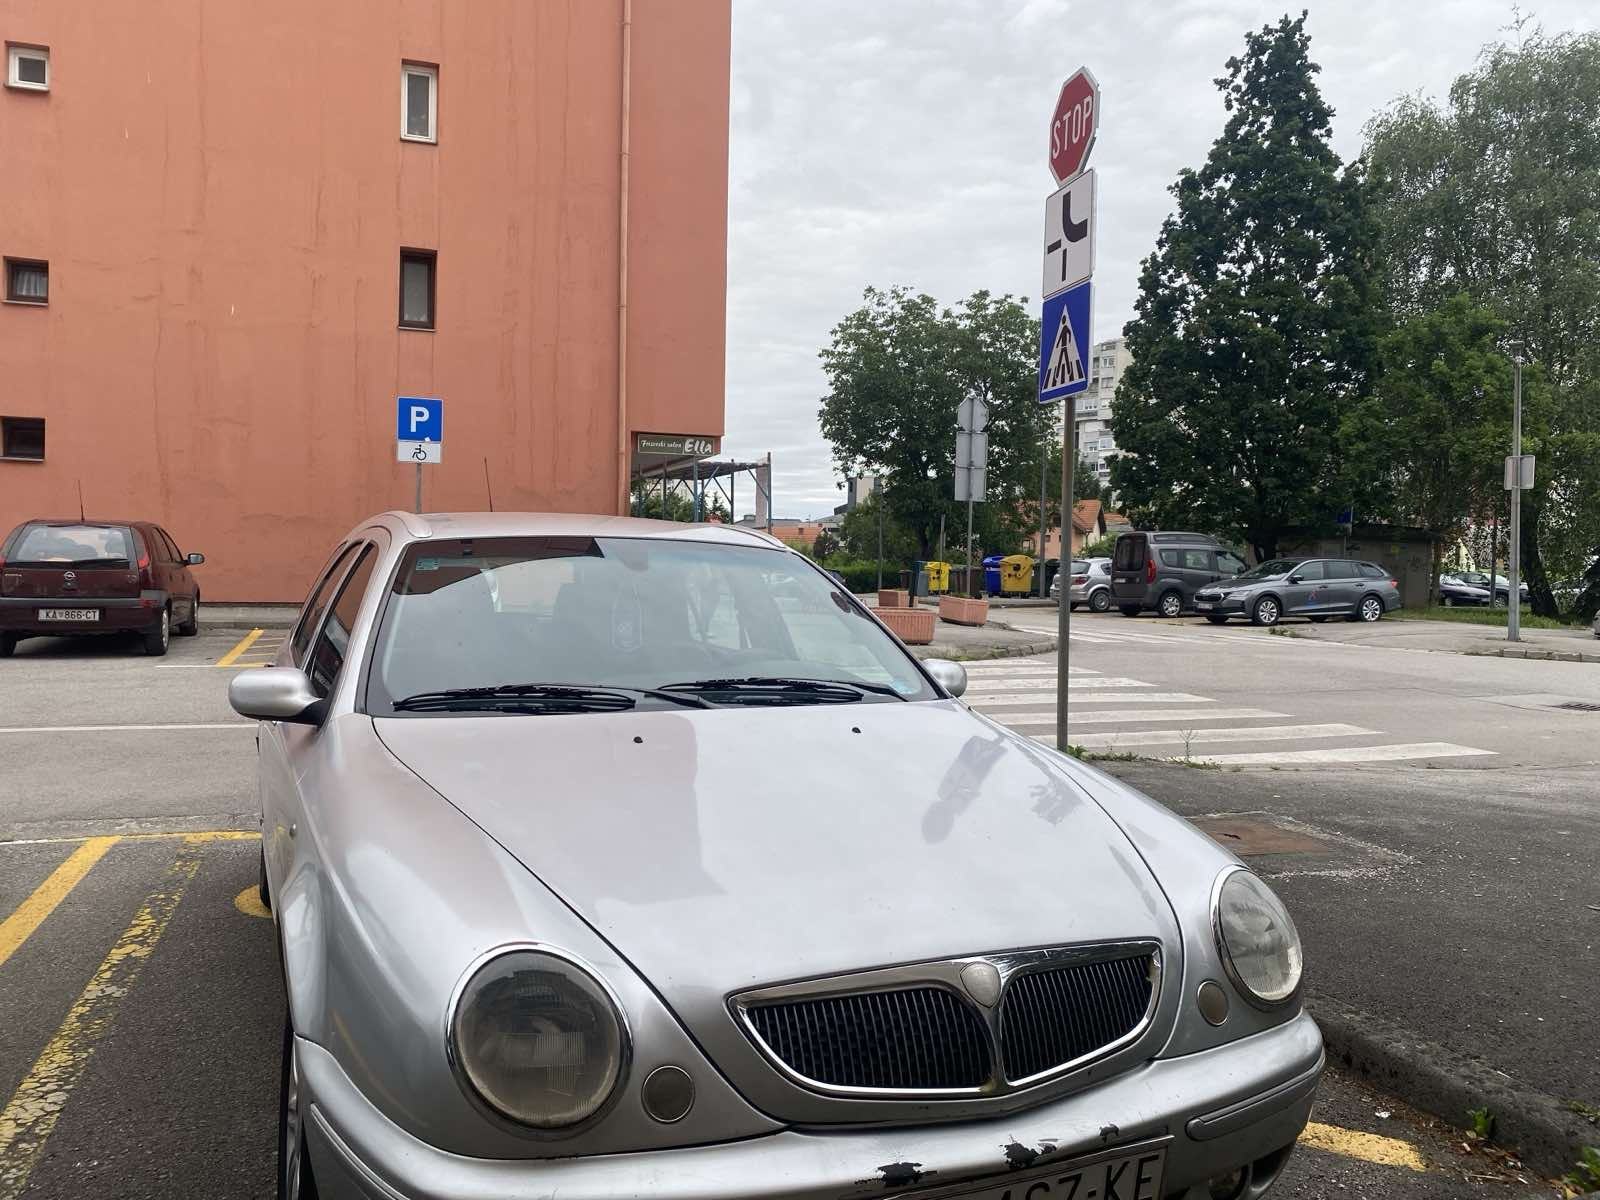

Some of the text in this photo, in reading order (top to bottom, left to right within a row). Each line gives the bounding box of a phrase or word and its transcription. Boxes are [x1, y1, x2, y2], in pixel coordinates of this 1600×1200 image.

[1053, 95, 1092, 159] STOP
[410, 406, 430, 432] P
[684, 439, 713, 455] Ella
[46, 610, 57, 619] KA
